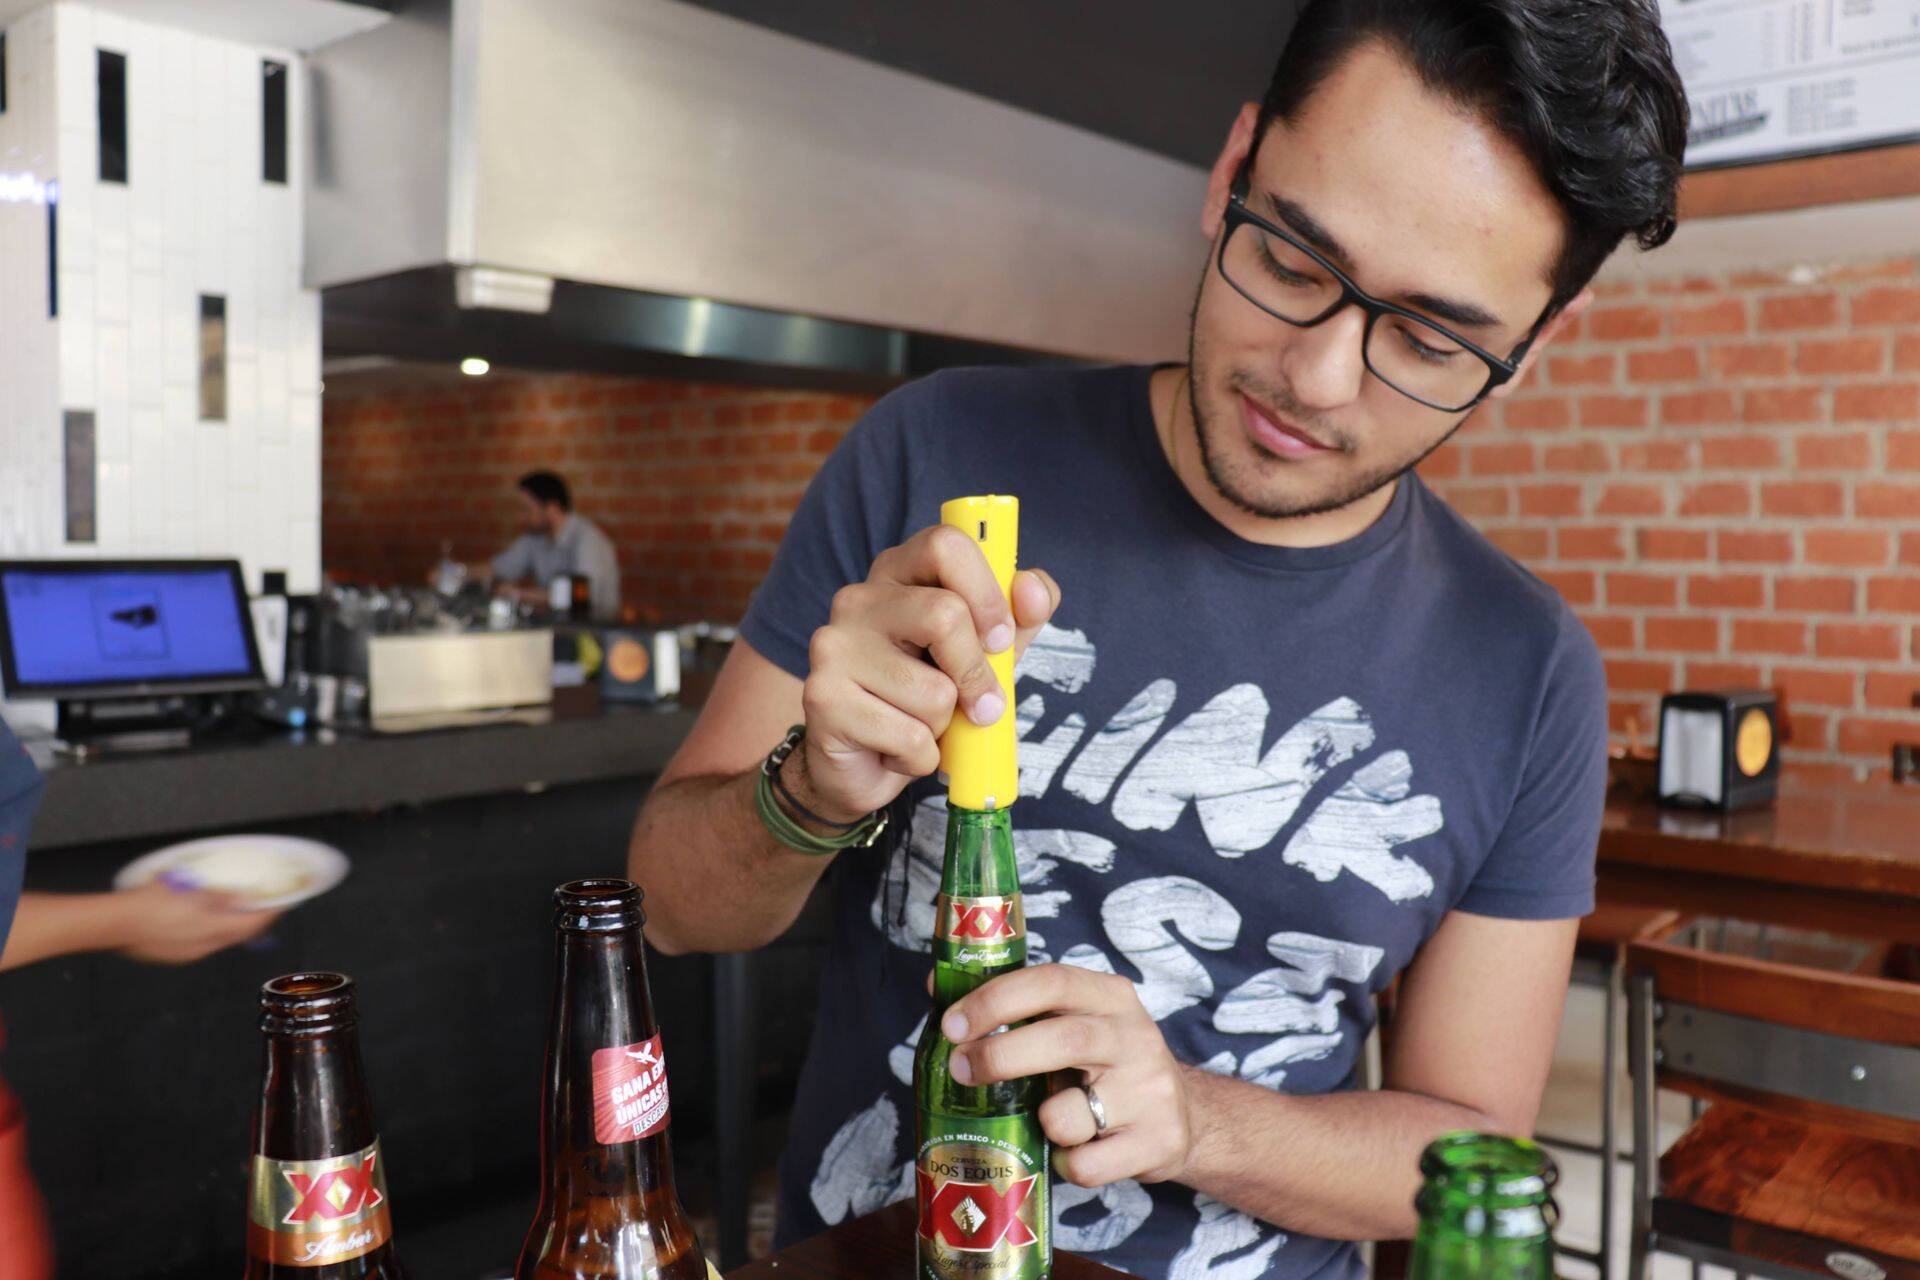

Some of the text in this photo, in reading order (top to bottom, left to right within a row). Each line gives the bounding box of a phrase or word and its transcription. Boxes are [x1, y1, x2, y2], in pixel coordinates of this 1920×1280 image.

[610, 1071, 652, 1106] GANA
[956, 1132, 989, 1143] MÉXICO
[930, 1160, 1014, 1180] DOS EQUIS
